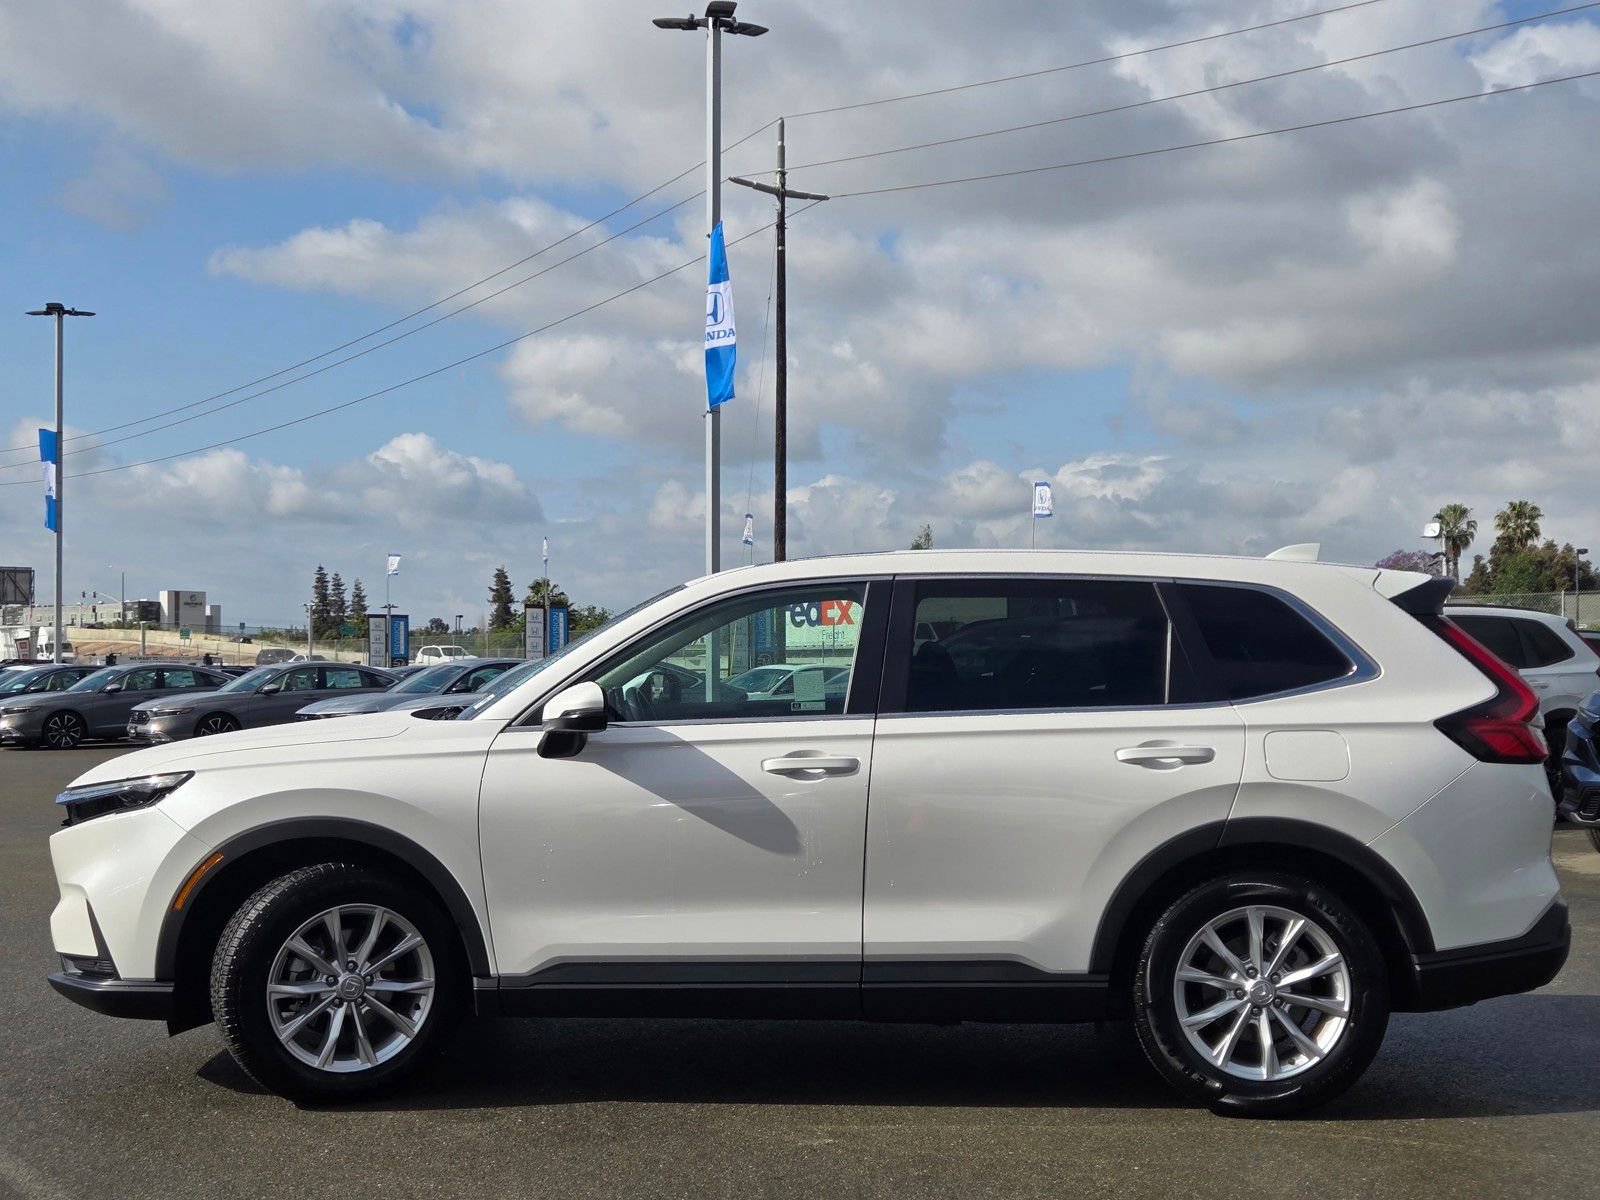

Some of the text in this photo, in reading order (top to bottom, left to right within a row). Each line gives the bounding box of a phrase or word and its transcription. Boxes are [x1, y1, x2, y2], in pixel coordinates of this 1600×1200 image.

[706, 327, 736, 341] NDA
[786, 600, 855, 628] edEx
[552, 612, 560, 649] ENVISION
